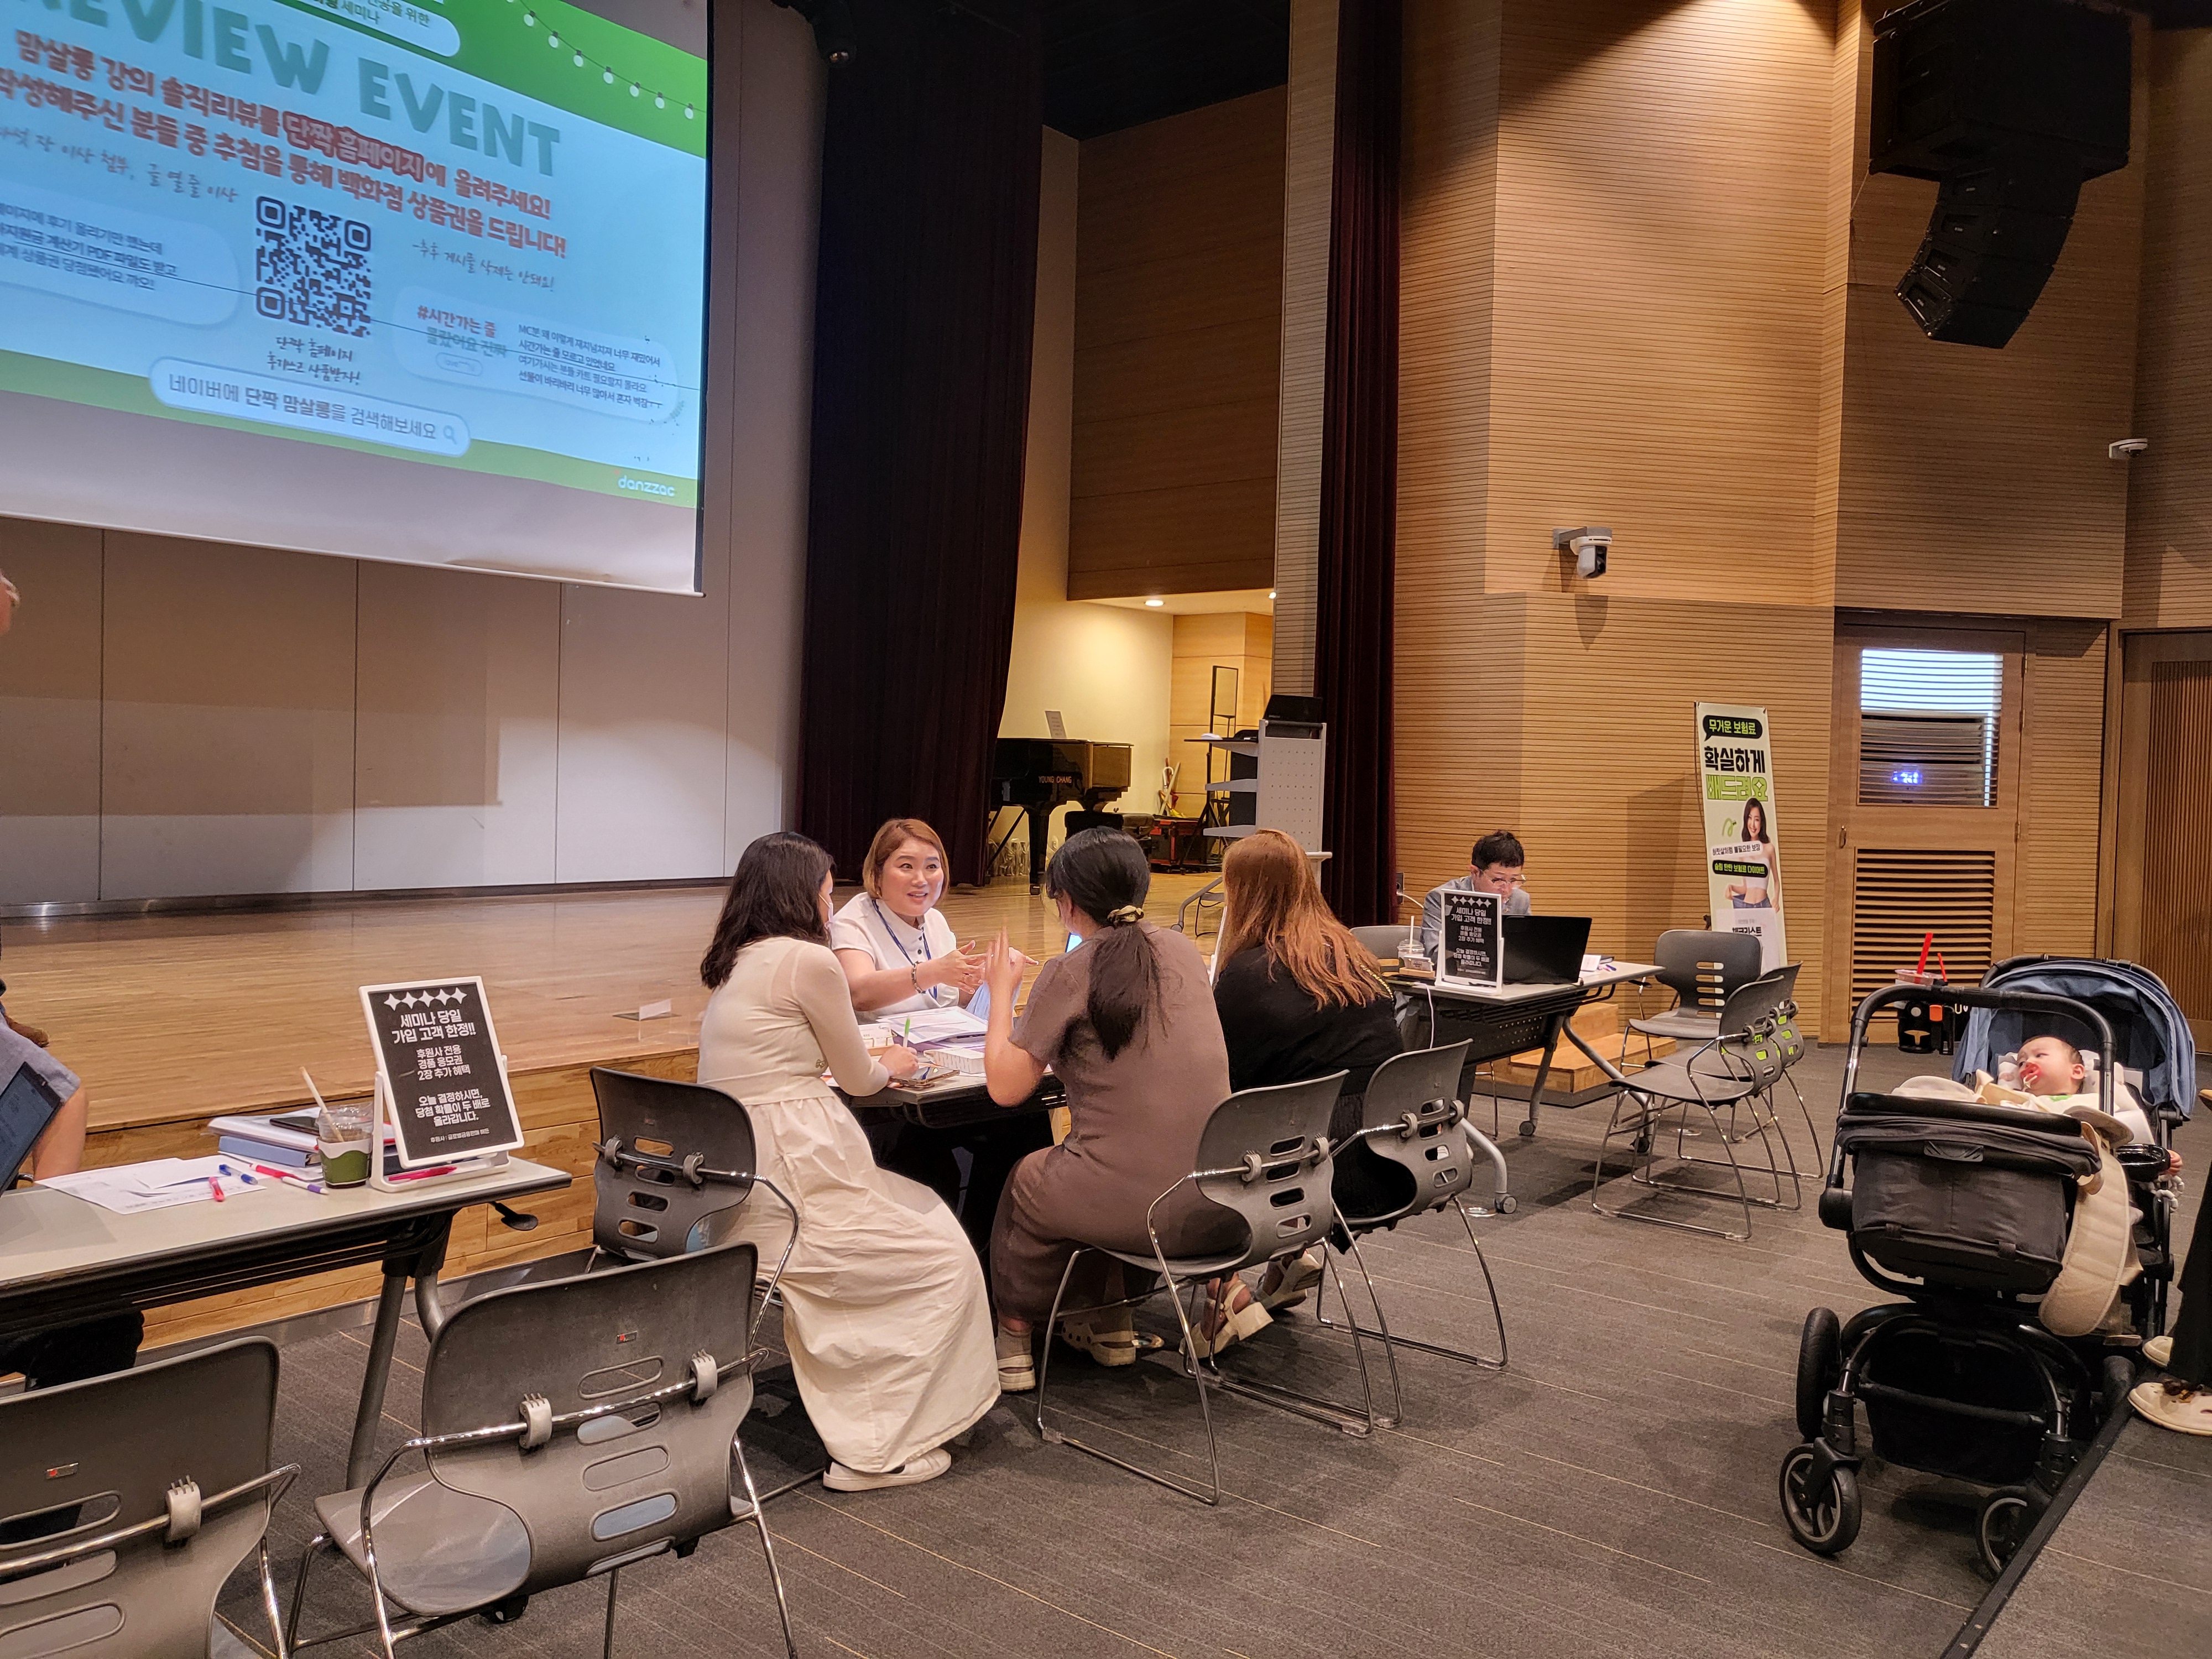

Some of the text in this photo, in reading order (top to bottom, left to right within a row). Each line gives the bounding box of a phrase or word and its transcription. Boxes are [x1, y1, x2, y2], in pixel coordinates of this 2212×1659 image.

[341, 0, 381, 25] 세미나
[405, 7, 430, 28] 위한
[15, 29, 551, 220] 맘살롱 강의 솔직리뷰를 단짝 홈페이지에 올려주세요!
[358, 57, 560, 176] EVENT
[131, 106, 179, 148] 분들
[184, 122, 208, 156] 중
[213, 132, 284, 178] 추첨을
[288, 153, 333, 189] 통해
[338, 168, 403, 212] 백화점
[407, 190, 484, 238] 상품권을
[487, 216, 566, 259] 드립니다!
[207, 186, 239, 202] 이상
[417, 305, 496, 338] #시간가는 줄
[308, 337, 353, 362] 홈페이지
[561, 349, 585, 364] 모르고
[614, 348, 630, 360] 너무
[576, 384, 591, 397] 너무
[169, 373, 436, 440] 네이버에 단짝 맘살롱을 검색해보세요
[618, 475, 675, 497] danzzac
[1709, 719, 1757, 735] 무거운 보험료
[1704, 745, 1766, 774] 확실하게
[1751, 843, 1761, 852] 보장
[1451, 914, 1463, 922] 가입
[1463, 915, 1476, 924] 고객
[1456, 906, 1486, 917] 세미나 당일
[400, 1009, 462, 1028] 세미나 당일
[392, 1022, 477, 1044] 가입 고객 한정!!
[416, 1044, 462, 1060] 후원사 전용
[418, 1055, 463, 1070] 경품 응모권
[417, 1064, 471, 1081] 2장 추가 혜택
[418, 1088, 483, 1107] 오늘 결정하시면,
[415, 1107, 434, 1119] 당첨
[462, 1100, 472, 1112] 두
[472, 1098, 491, 1110] 배로
[433, 1110, 479, 1128] 올라갑니다.
